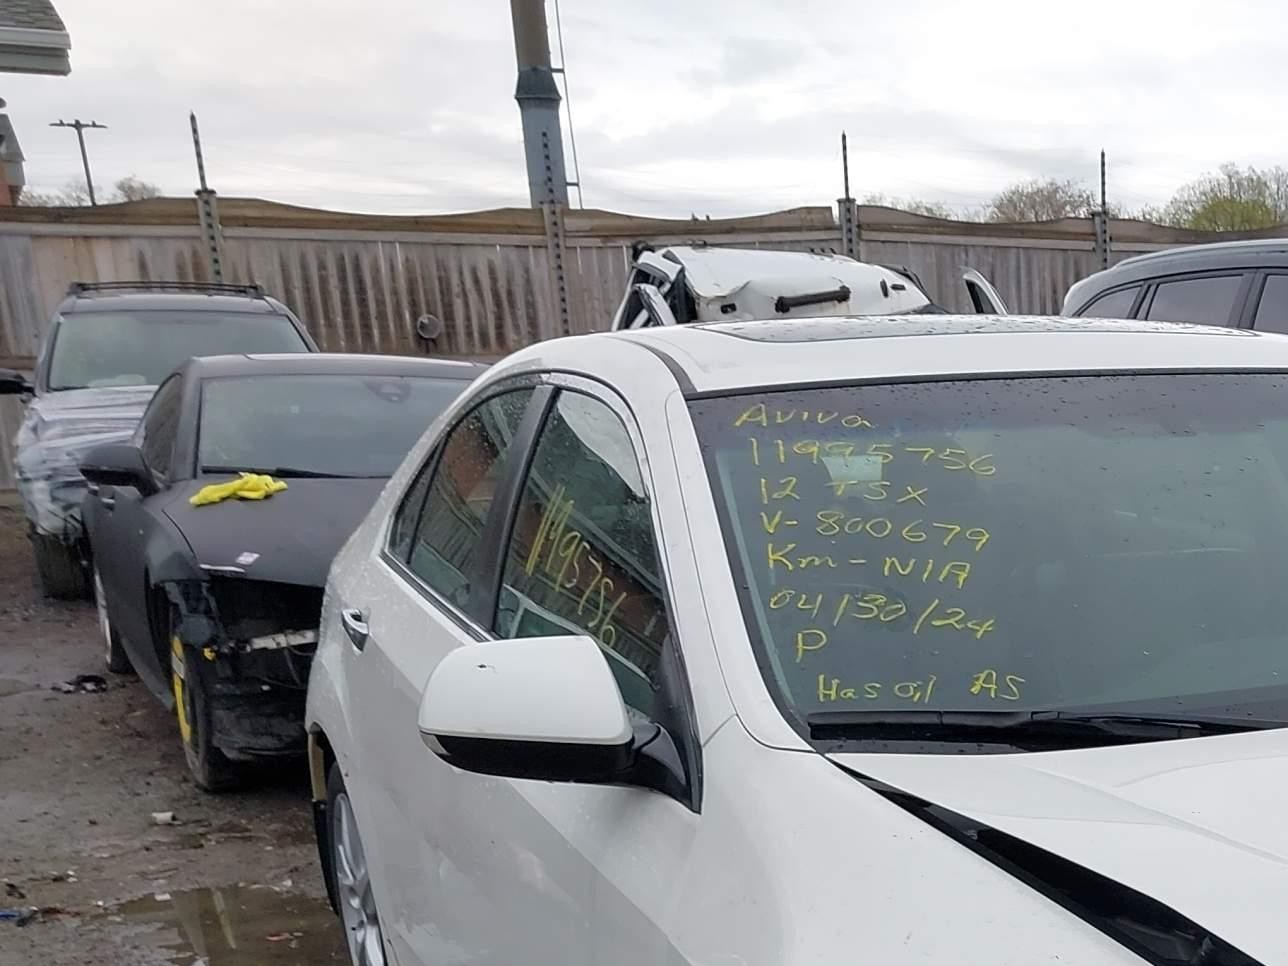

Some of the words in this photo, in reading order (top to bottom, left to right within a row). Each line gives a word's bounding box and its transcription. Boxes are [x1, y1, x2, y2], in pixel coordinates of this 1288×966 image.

[734, 403, 876, 429] Aviva
[750, 437, 996, 475] 11995756
[760, 477, 800, 504] 12
[816, 510, 991, 551] 800679
[769, 589, 996, 639] 04/30/24
[795, 629, 828, 663] P
